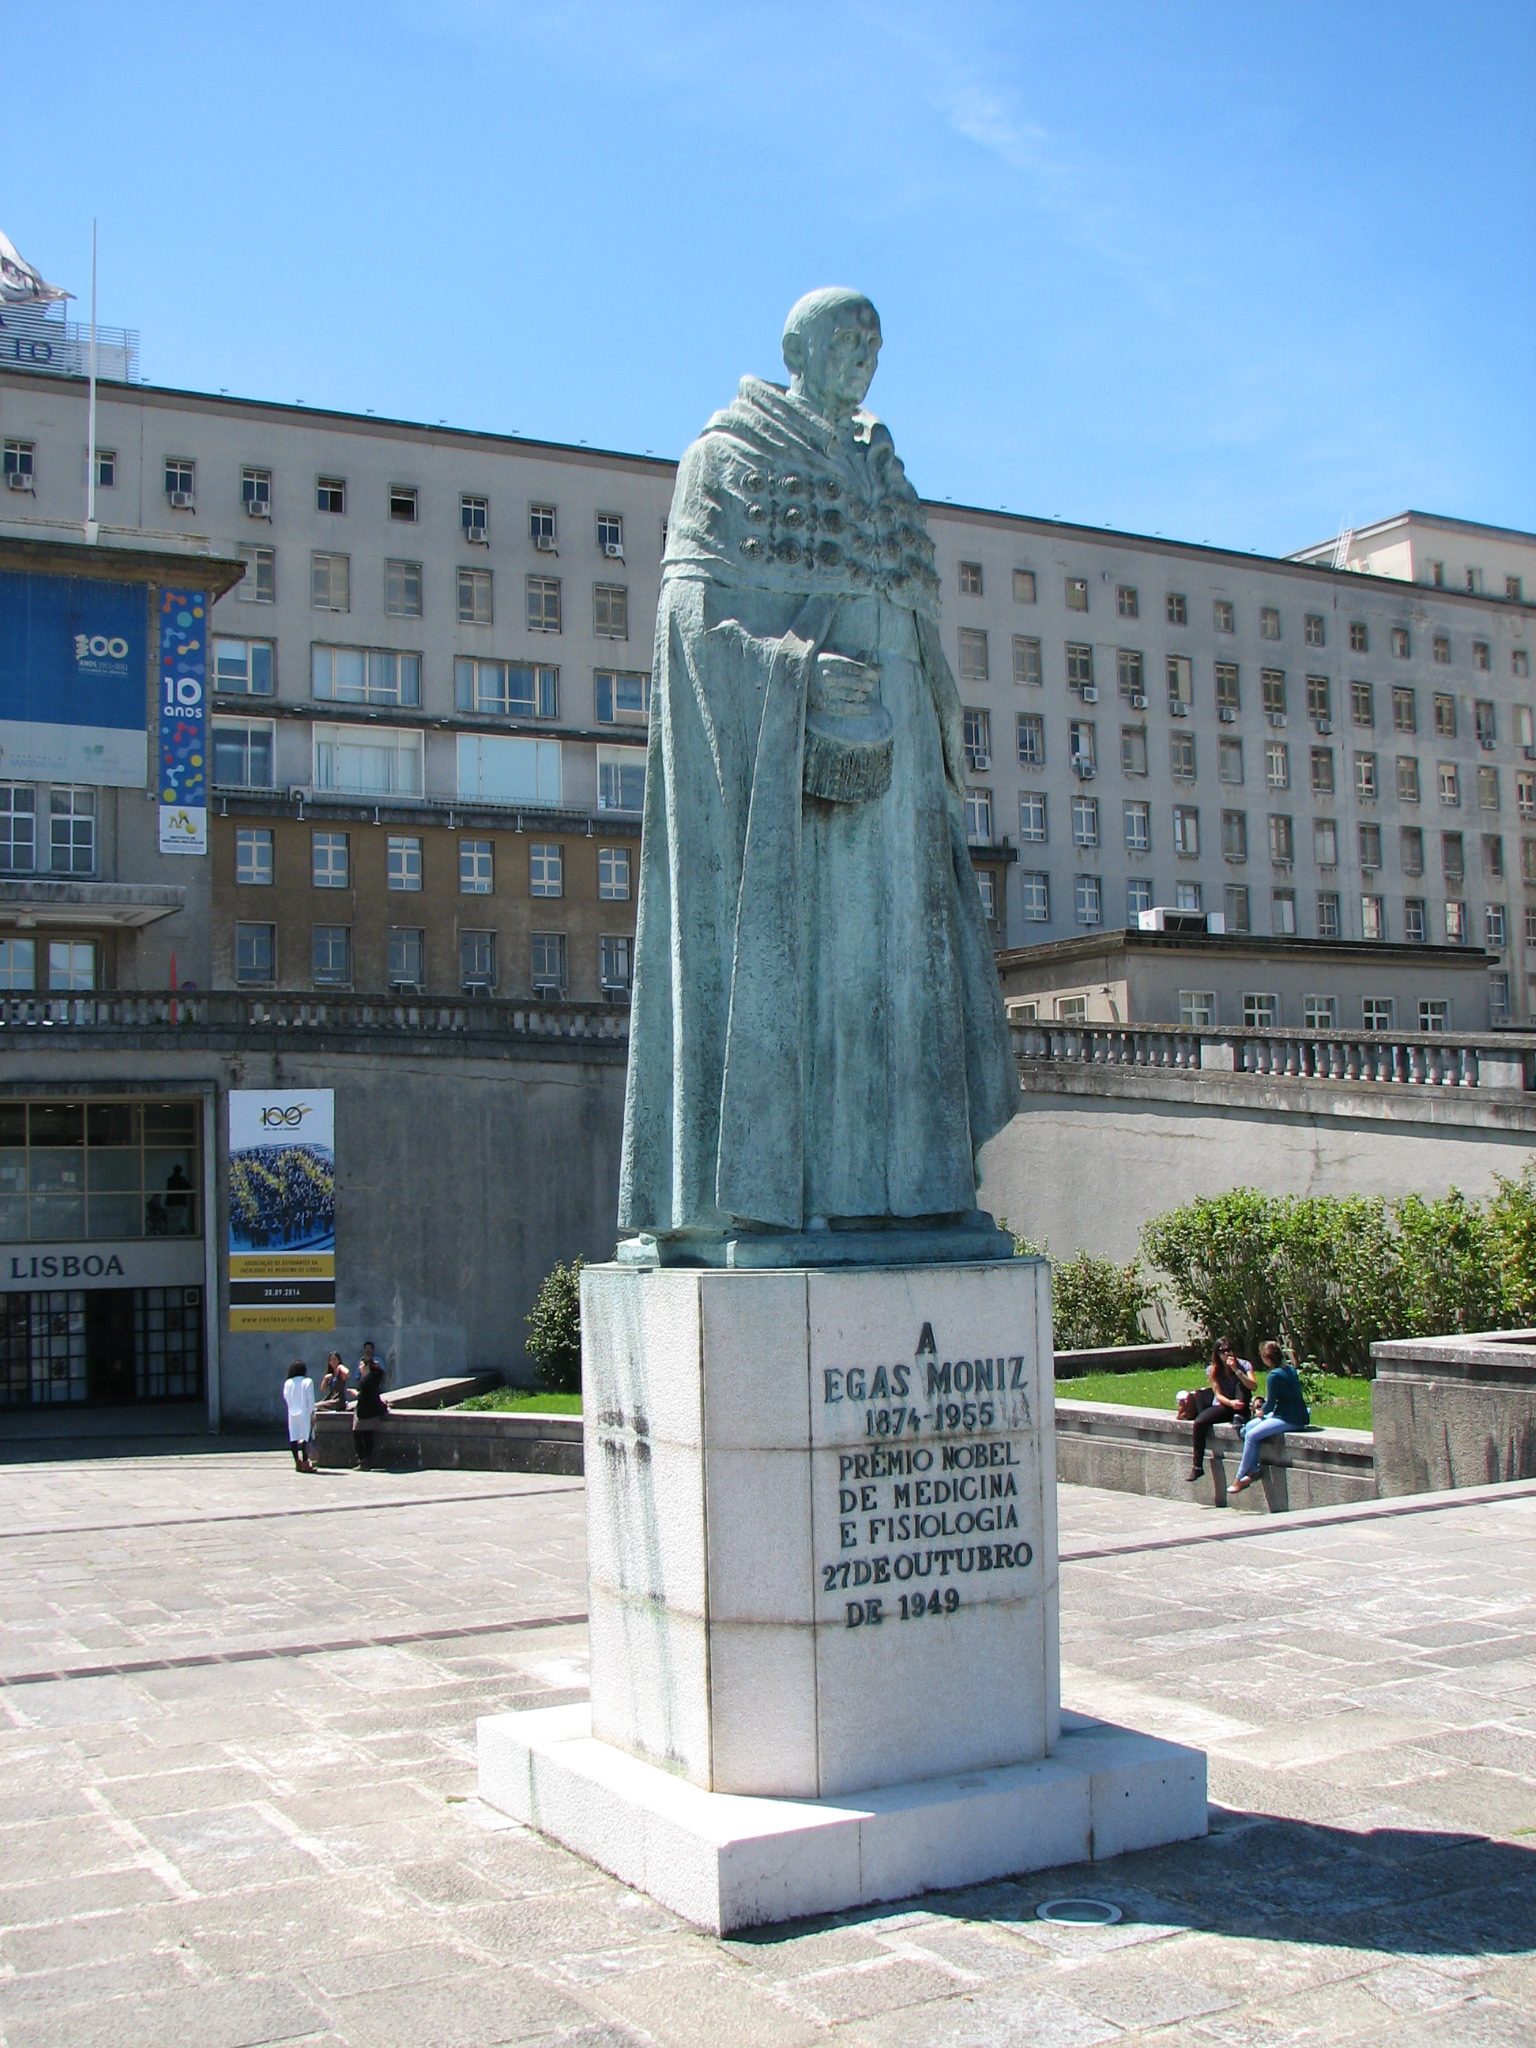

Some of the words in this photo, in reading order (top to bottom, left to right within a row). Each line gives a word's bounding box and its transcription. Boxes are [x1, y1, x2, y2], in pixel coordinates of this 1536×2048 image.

[165, 677, 202, 705] 10
[164, 706, 202, 718] anos
[262, 1106, 302, 1126] 100
[10, 1254, 124, 1279] LISBOA
[914, 1321, 937, 1355] A
[824, 1364, 911, 1403] EGAS
[927, 1356, 1028, 1394] MONIZ
[866, 1401, 994, 1436] 1874-1955
[839, 1443, 934, 1481] PRÉMIO
[942, 1441, 1020, 1471] NOBEL
[839, 1485, 877, 1514] DE
[894, 1472, 1018, 1509] MEDICINA
[840, 1521, 857, 1548] E
[869, 1504, 1019, 1544] FISIOLOGIA
[894, 1542, 1033, 1580] OUTUBRO
[846, 1599, 882, 1628] DE
[898, 1588, 960, 1620] 1949
